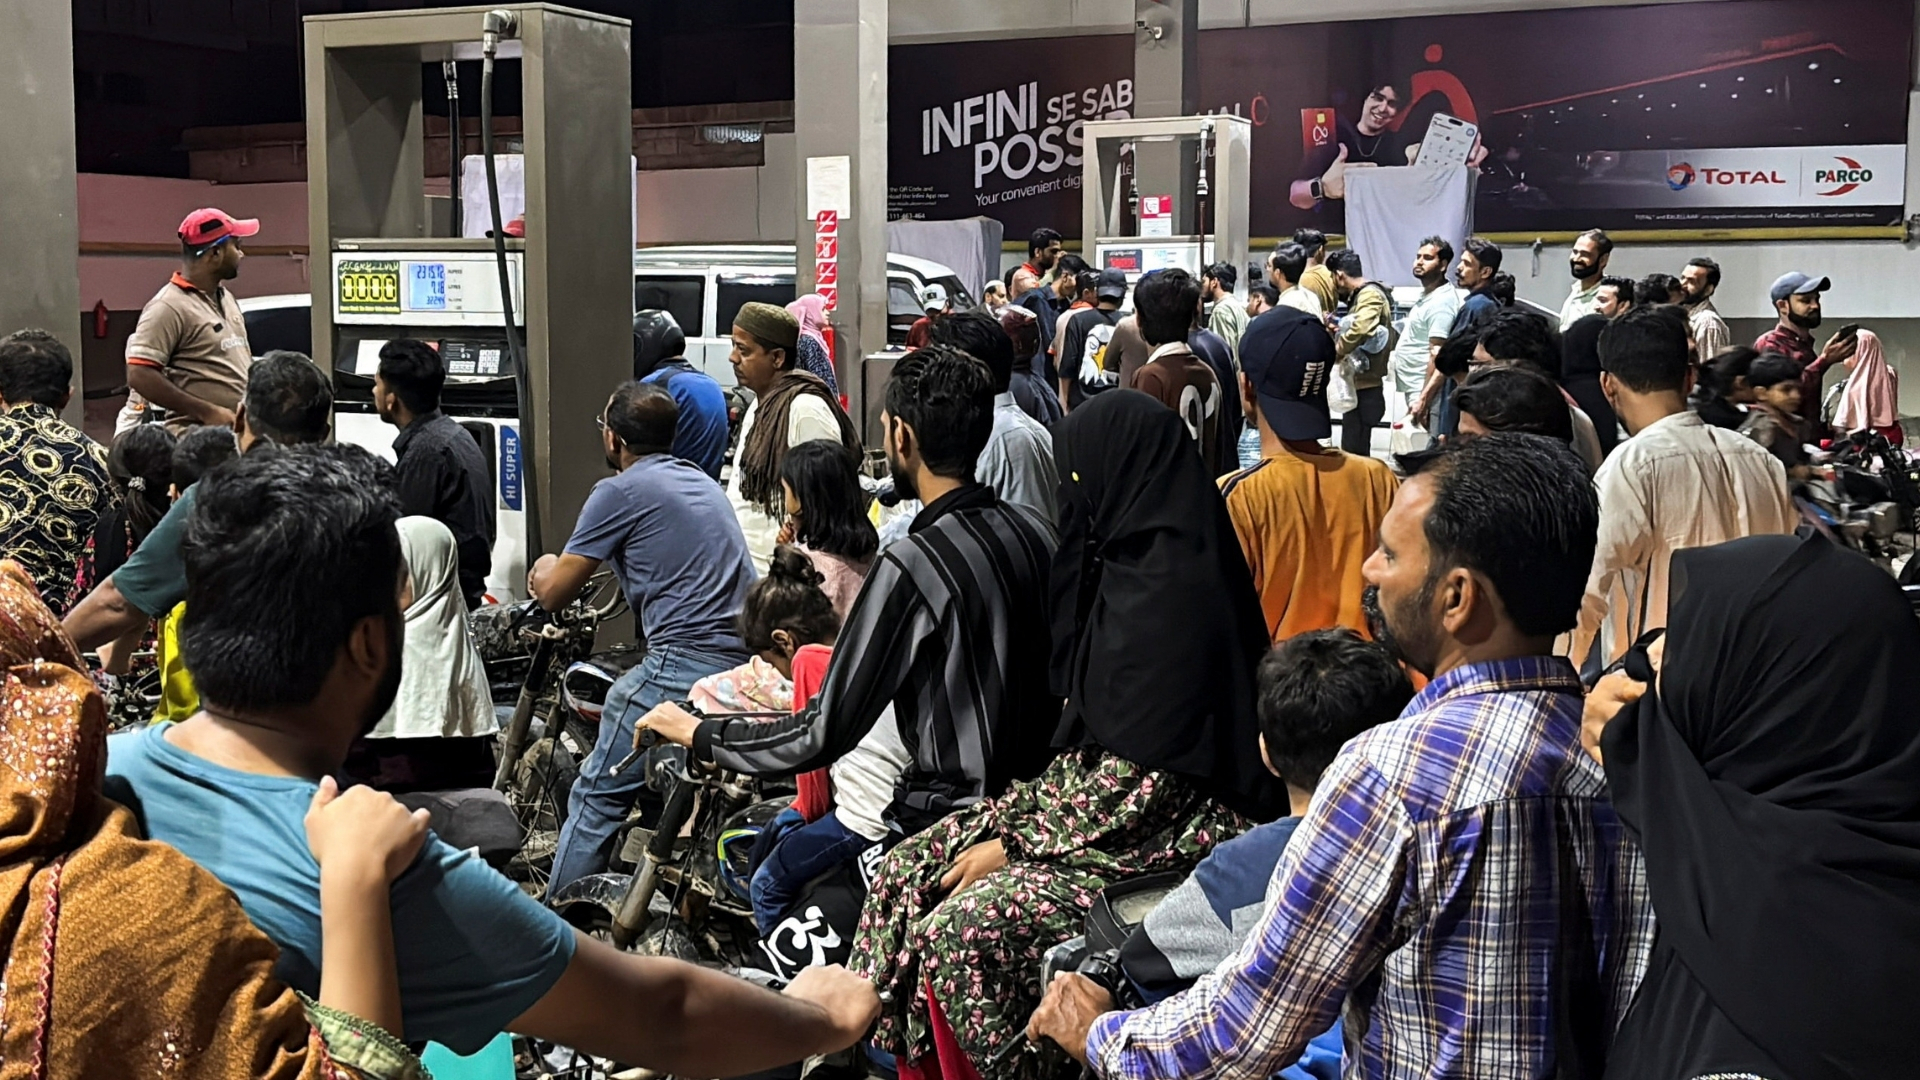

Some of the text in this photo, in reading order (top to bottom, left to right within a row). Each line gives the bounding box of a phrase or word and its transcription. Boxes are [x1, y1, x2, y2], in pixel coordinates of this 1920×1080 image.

[922, 79, 1133, 155] INFINI SE SAB
[1700, 168, 1786, 184] TOTAL
[1815, 169, 1873, 183] PARCO
[975, 192, 1000, 206] Your
[1001, 178, 1061, 201] convenient
[505, 436, 517, 499] HI SUPER
